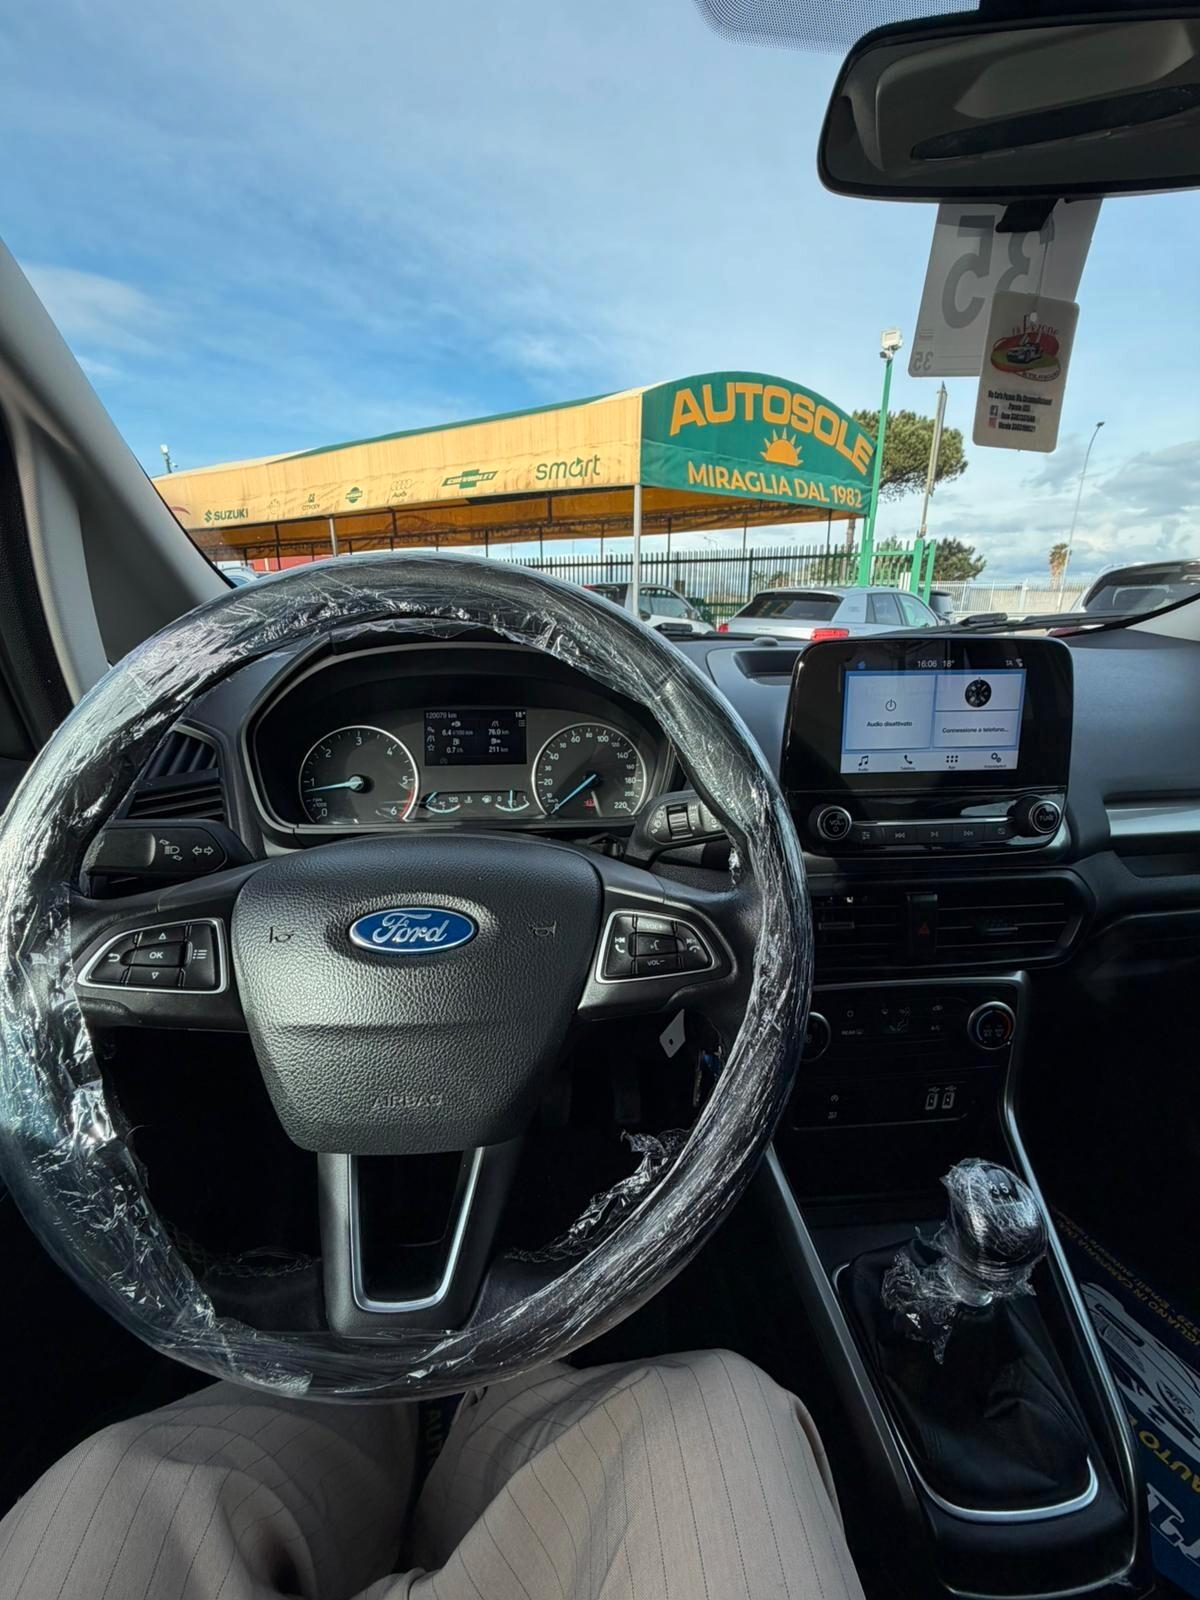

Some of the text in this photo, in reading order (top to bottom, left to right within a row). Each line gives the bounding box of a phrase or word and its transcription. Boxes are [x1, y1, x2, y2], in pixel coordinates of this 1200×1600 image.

[669, 381, 875, 476] AUTOSOLE
[535, 454, 600, 480] smart
[688, 461, 862, 508] MIRAGLIA DAL 1982
[214, 508, 249, 521] SUZUKI
[917, 660, 937, 668] 16:06
[942, 726, 978, 734] Connessione
[356, 736, 362, 746] 3
[571, 735, 581, 743] 60
[597, 735, 610, 743] 100
[325, 748, 332, 758] 2
[387, 747, 393, 756] 4
[550, 752, 559, 761] 40
[310, 777, 315, 787] 1
[402, 775, 408, 785] 5
[614, 801, 627, 809] 220
[321, 808, 328, 817] 0
[391, 806, 398, 816] 6
[372, 912, 449, 944] Ford
[149, 950, 164, 960] OK
[1000, 1183, 1009, 1194] 5
